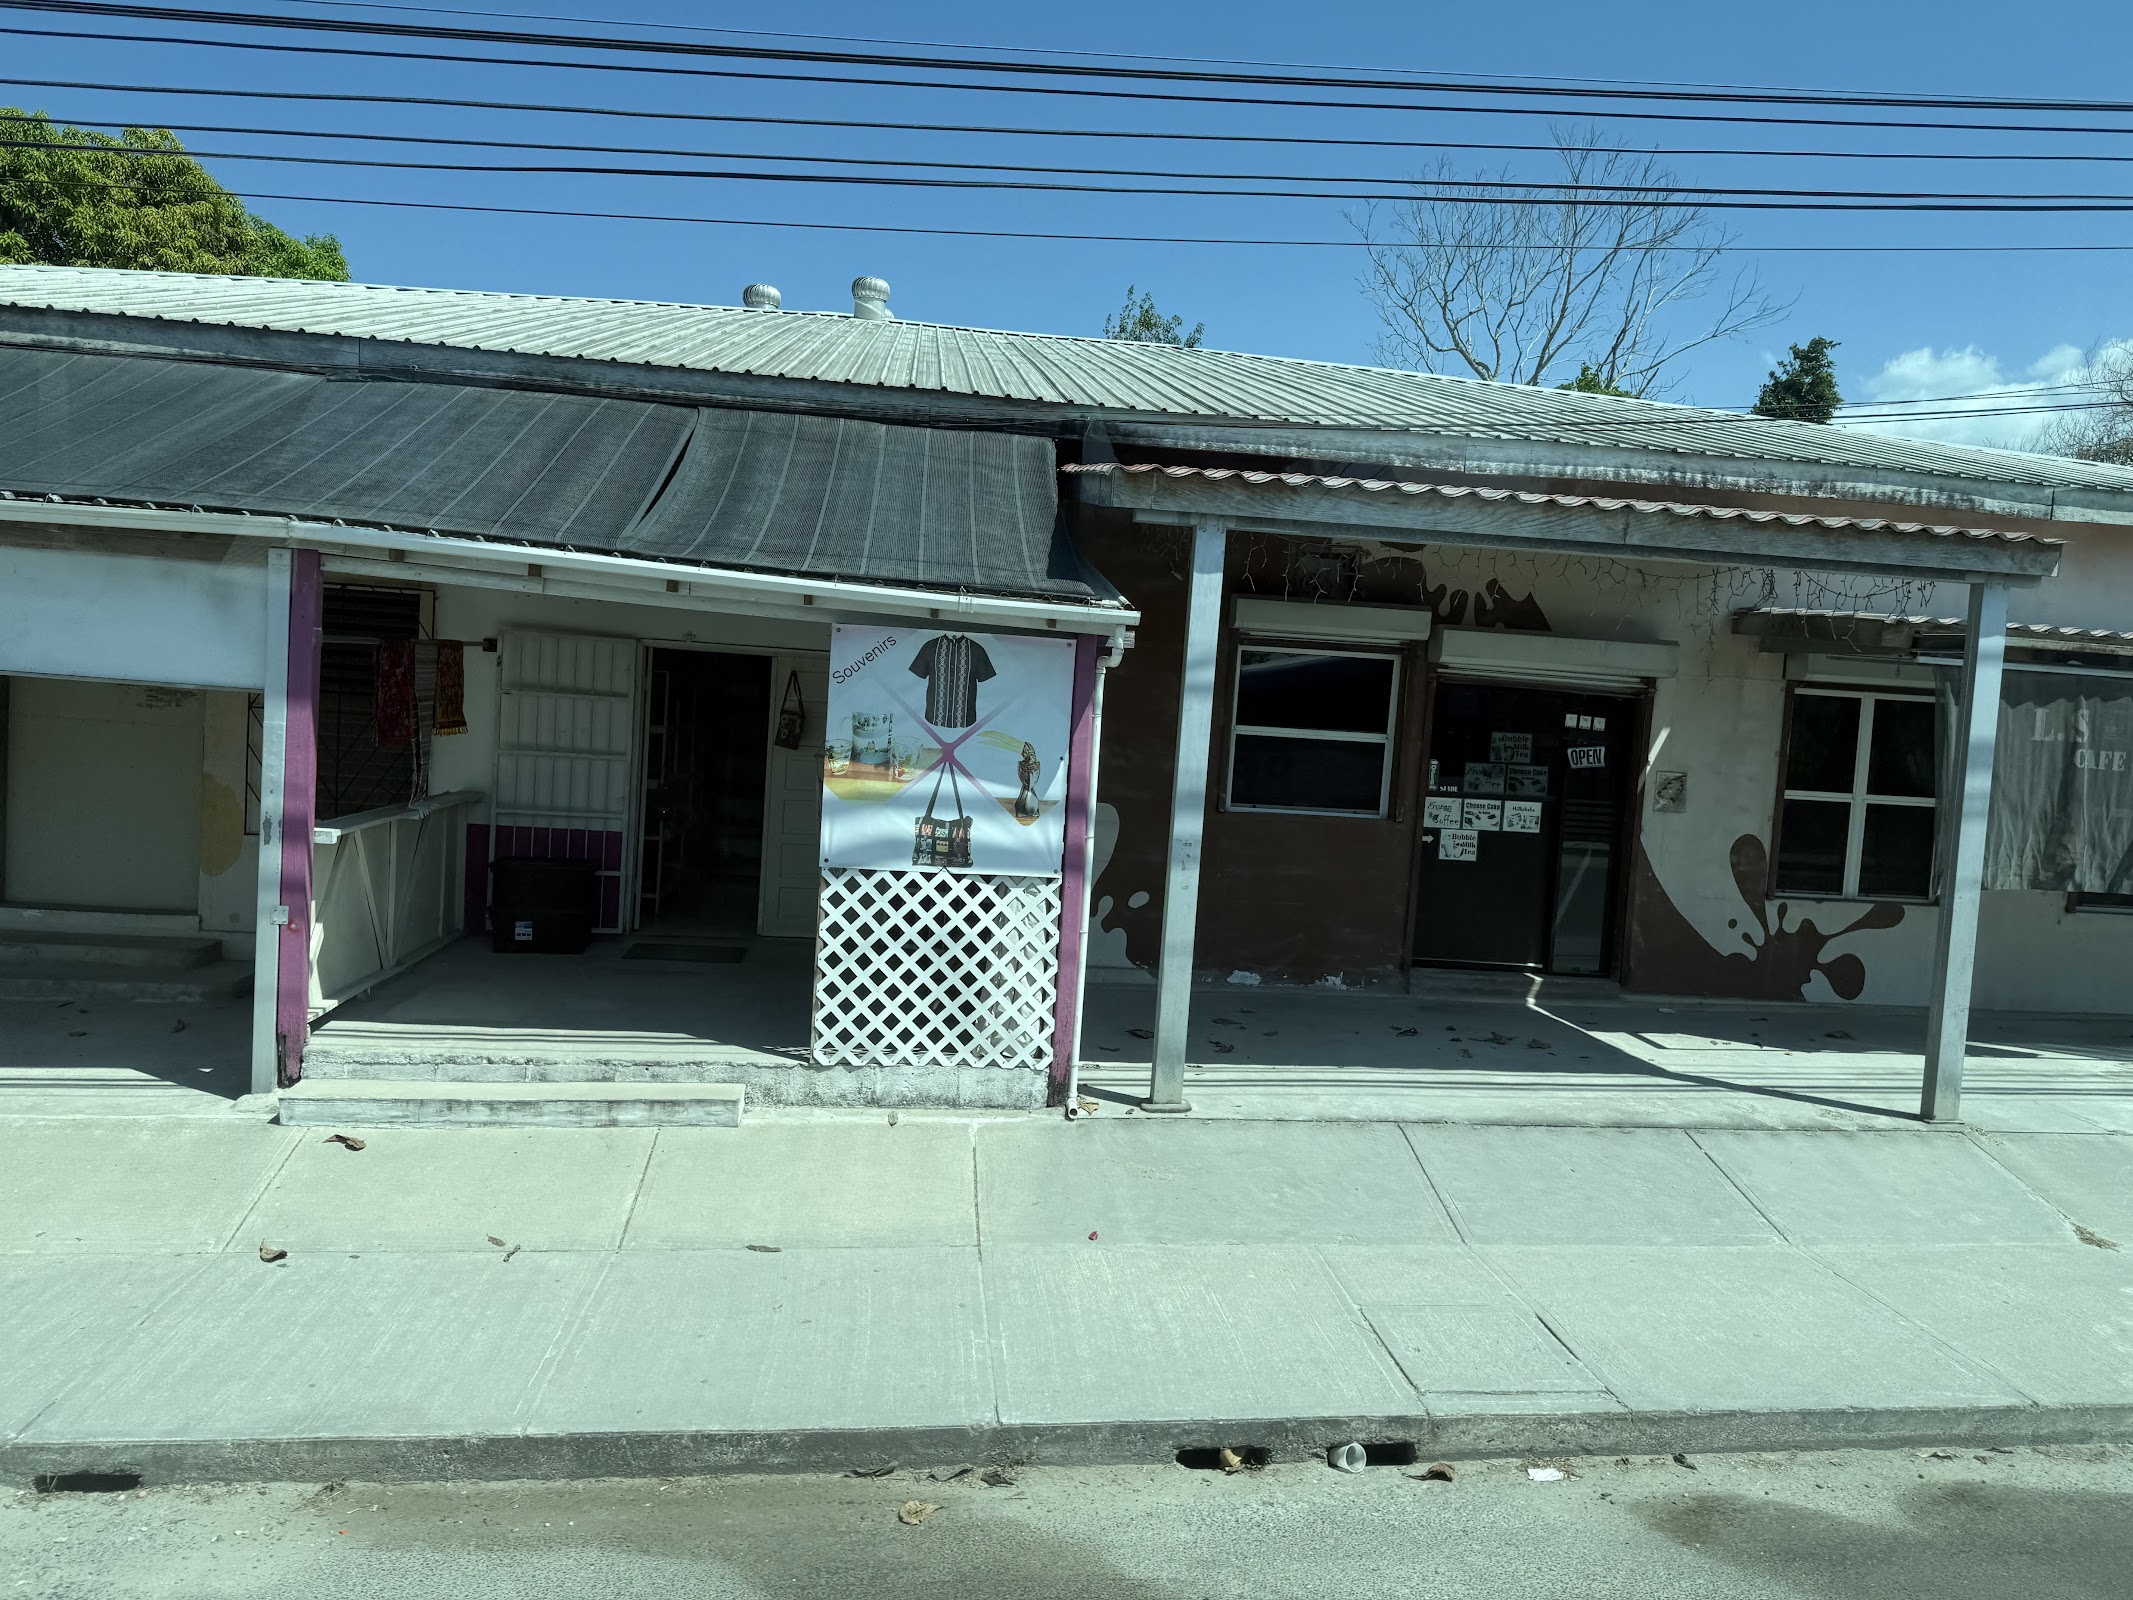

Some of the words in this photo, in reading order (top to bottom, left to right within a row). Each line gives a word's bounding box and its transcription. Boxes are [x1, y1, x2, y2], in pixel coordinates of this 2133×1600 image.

[832, 636, 897, 684] Souvenirs
[1501, 734, 1529, 743] Bubble
[1513, 743, 1530, 751] Milk
[1570, 749, 1602, 766] OPEN
[2074, 748, 2127, 771] CAFE
[1532, 768, 1548, 776] Cake
[1474, 777, 1501, 789] Coffee
[1439, 785, 1458, 793] SLIDE
[1487, 803, 1501, 811] Cake
[1432, 814, 1459, 827] Coffee
[1452, 833, 1477, 841] Bubble
[1461, 841, 1476, 849] Milk
[1464, 848, 1476, 856] Tea
